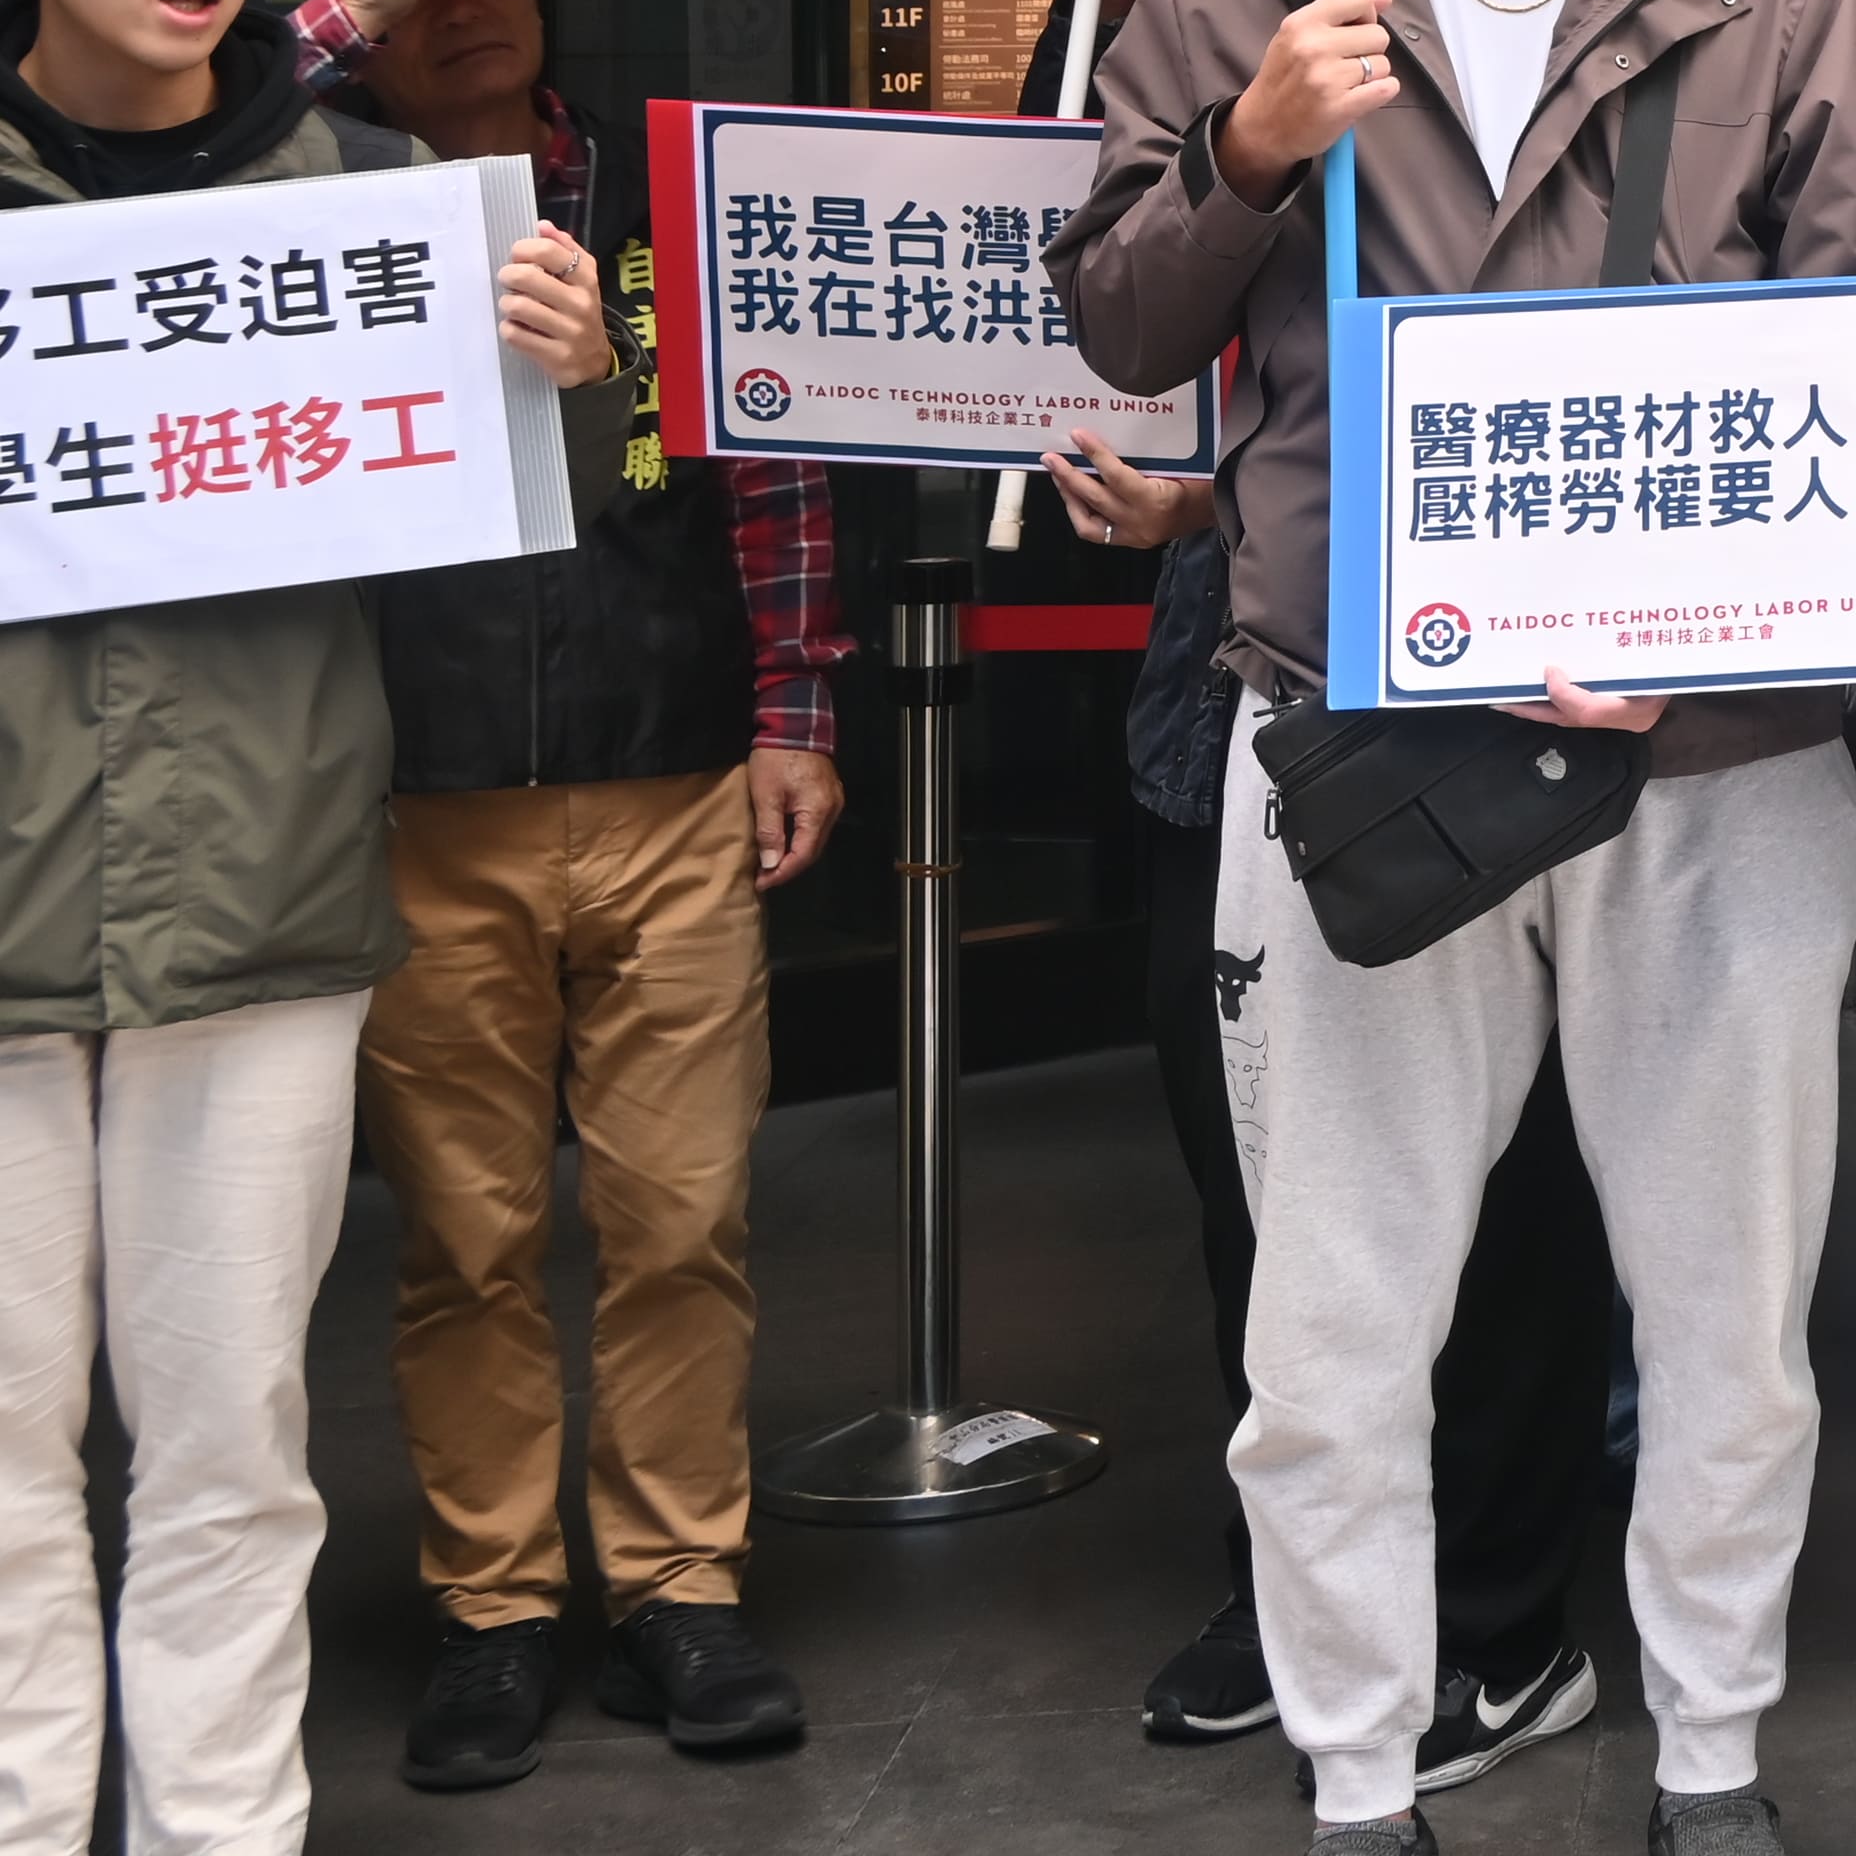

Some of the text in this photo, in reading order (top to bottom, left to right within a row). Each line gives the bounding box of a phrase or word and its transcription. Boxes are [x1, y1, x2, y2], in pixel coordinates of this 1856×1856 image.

[880, 7, 922, 28] 11F
[880, 72, 922, 93] 10F
[804, 383, 1175, 414] TAIDOC TECHNOLOGY LABOR UNION
[915, 407, 1054, 428] 泰博科技企業工會
[1487, 610, 1575, 632] TAIDOC
[1584, 602, 1744, 626] TECHNOLOGY
[1753, 598, 1830, 618] LABOR
[1615, 623, 1775, 648] 泰博科技企業工會
